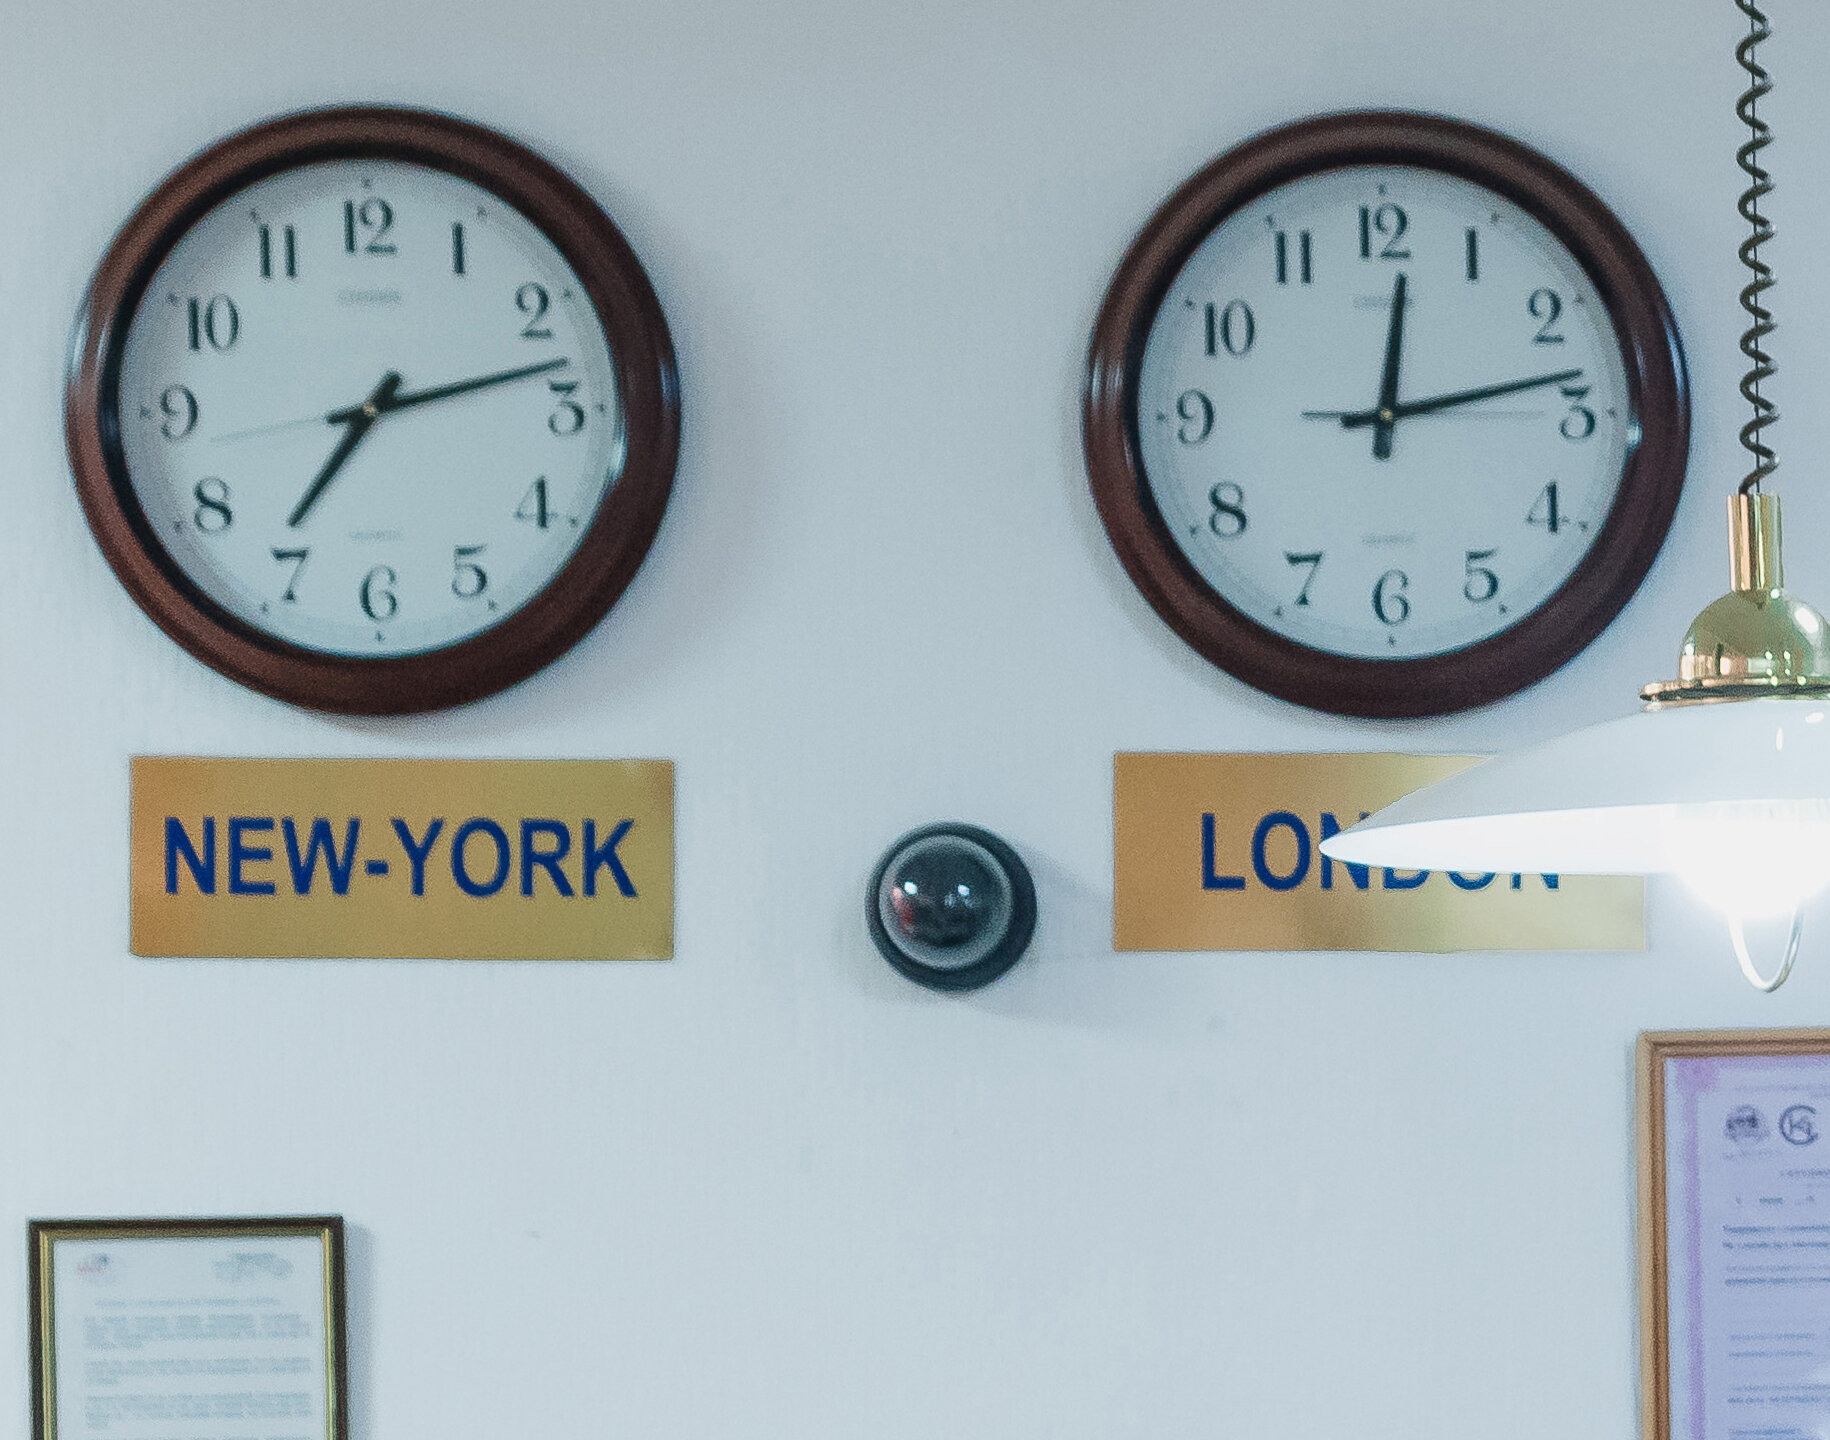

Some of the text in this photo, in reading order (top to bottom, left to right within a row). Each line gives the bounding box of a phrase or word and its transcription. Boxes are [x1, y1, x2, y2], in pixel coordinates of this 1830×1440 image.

[259, 223, 298, 279] 11
[344, 197, 397, 255] 12
[452, 221, 466, 278] 1
[1358, 203, 1411, 260] 12
[1274, 230, 1312, 284] 11
[1465, 227, 1479, 282] 1
[187, 294, 239, 351] 10
[515, 282, 554, 340] 2
[1203, 299, 1256, 357] 10
[1527, 288, 1564, 344] 2
[159, 384, 198, 441] 9
[548, 379, 586, 435] 3
[1176, 389, 1215, 446] 9
[1558, 383, 1596, 440] 3
[193, 479, 233, 533] 8
[514, 475, 558, 530] 4
[1208, 482, 1248, 538] 8
[1524, 480, 1570, 534] 4
[271, 548, 309, 602] 7
[359, 565, 398, 622] 6
[452, 546, 488, 598] 5
[1285, 552, 1323, 606] 7
[1372, 569, 1410, 626] 6
[1463, 549, 1499, 603] 5
[163, 818, 638, 898] NEW-YORK
[1202, 810, 1561, 891] LON
